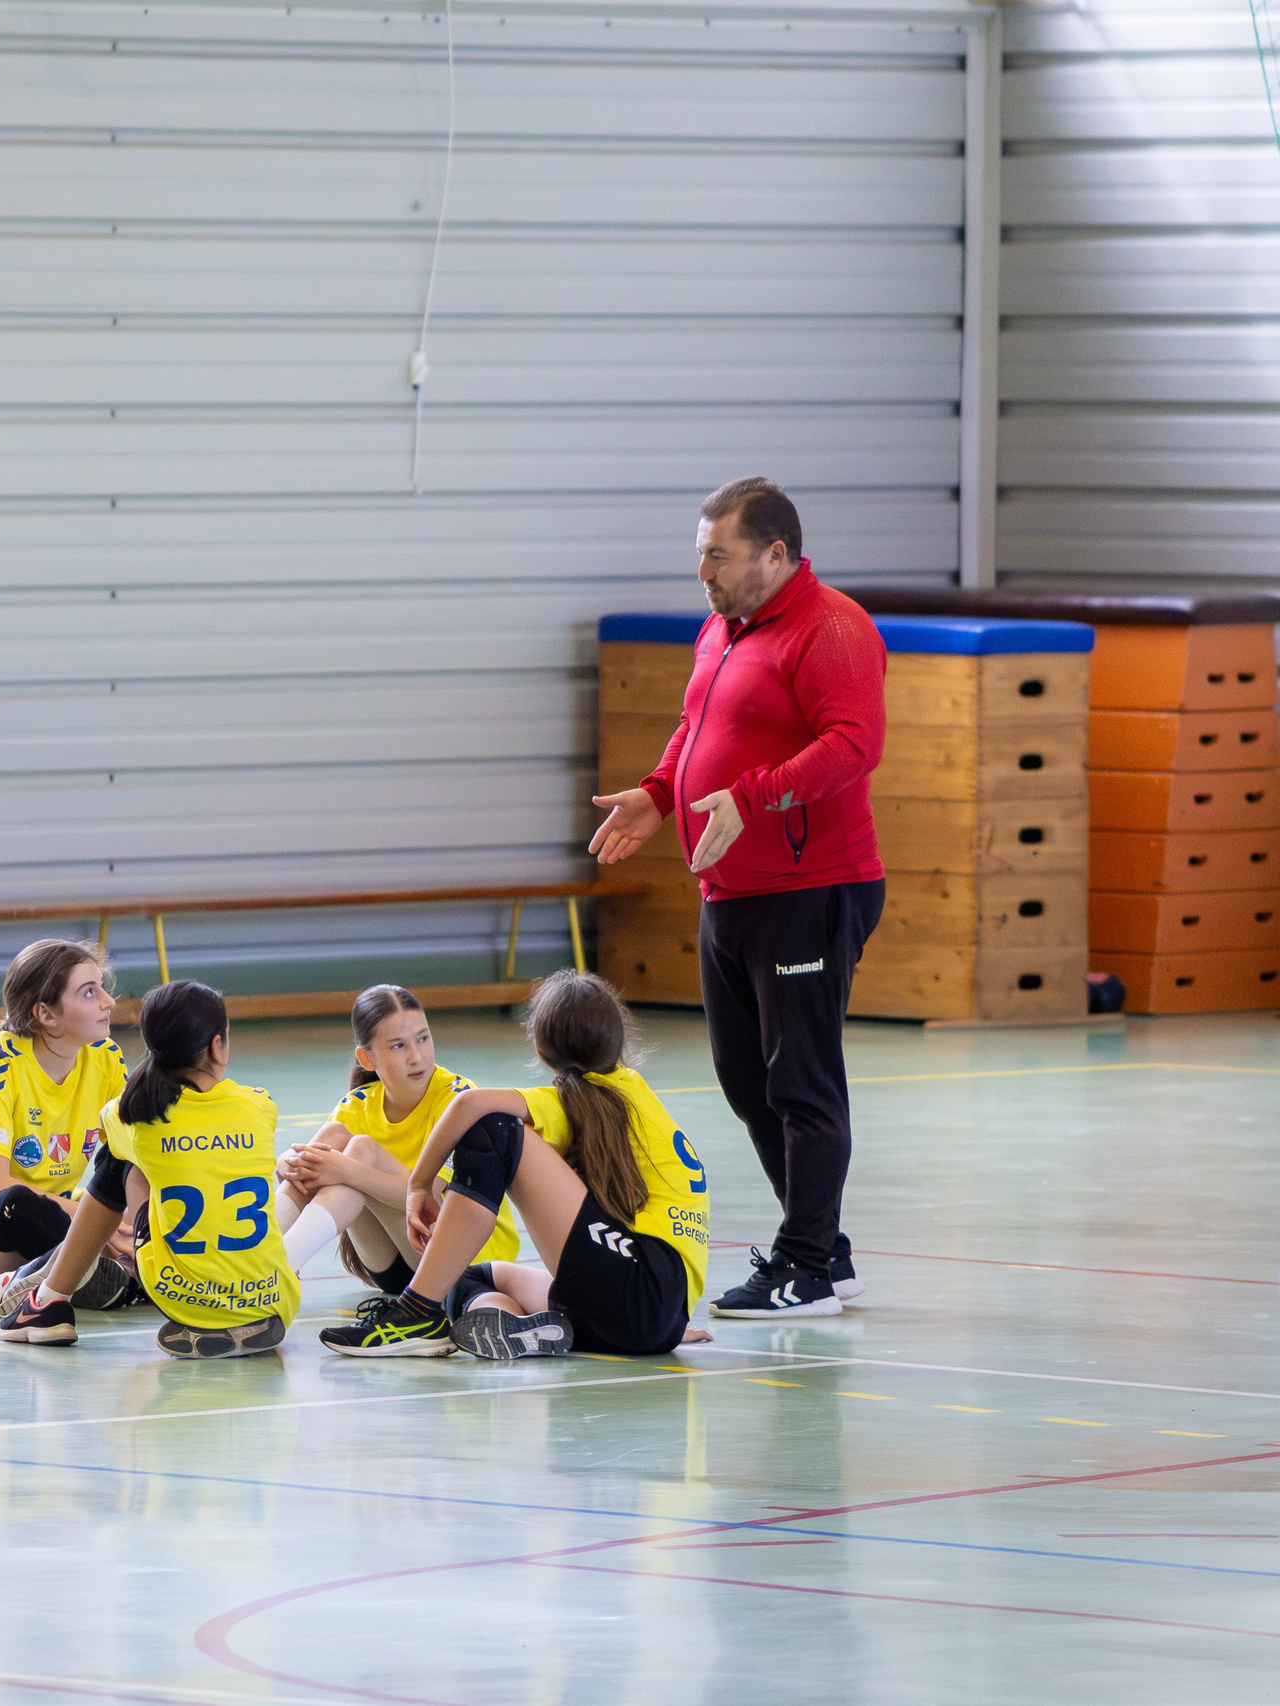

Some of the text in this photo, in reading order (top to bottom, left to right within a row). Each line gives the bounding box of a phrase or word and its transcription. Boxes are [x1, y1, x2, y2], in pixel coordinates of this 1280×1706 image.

[776, 957, 824, 976] hummel
[160, 1132, 255, 1154] MOCANU
[672, 1130, 707, 1193] 9
[160, 1176, 270, 1255] 23
[154, 1280, 281, 1311] Beresti-Tazlau
[240, 1269, 278, 1295] local
